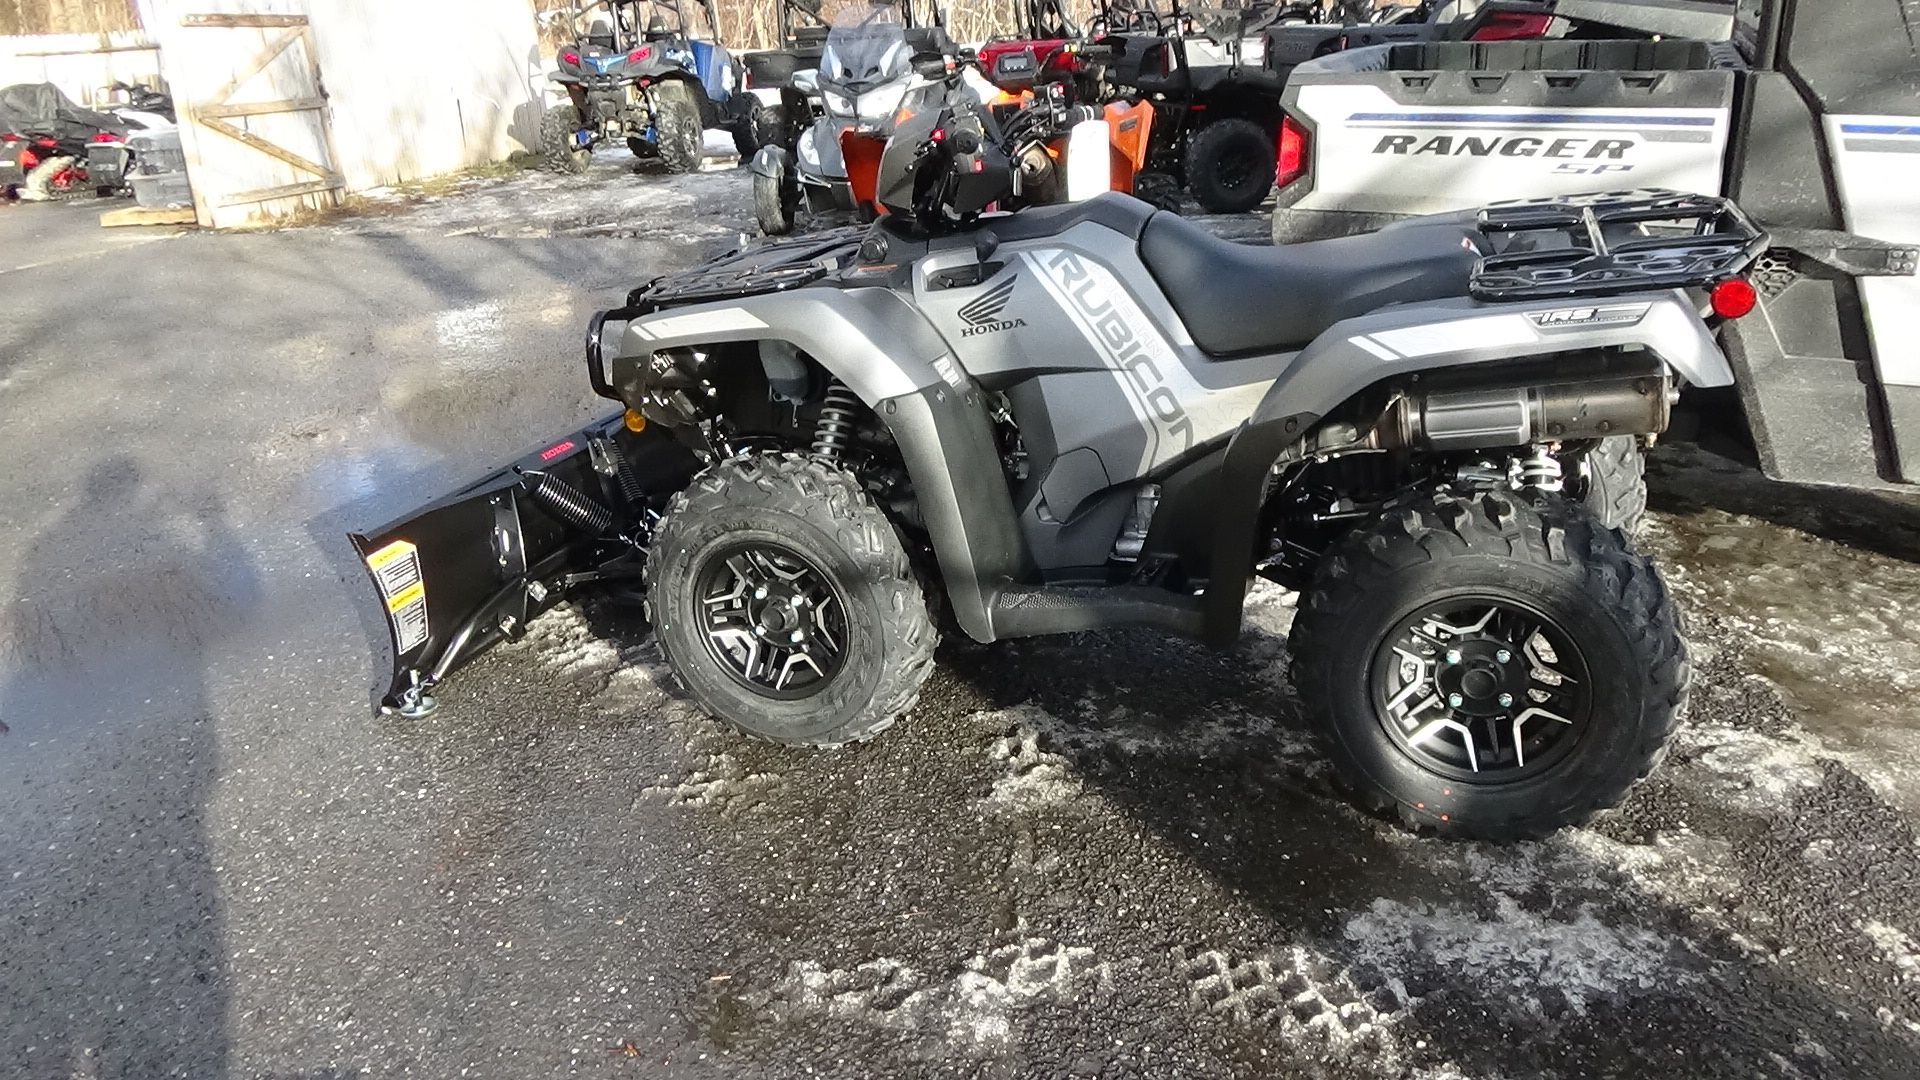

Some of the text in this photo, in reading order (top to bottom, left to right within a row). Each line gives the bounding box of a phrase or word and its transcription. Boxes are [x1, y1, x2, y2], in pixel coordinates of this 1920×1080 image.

[1371, 135, 1635, 159] RANGER
[1552, 163, 1635, 175] SP
[961, 318, 1027, 338] HONDA
[1048, 250, 1194, 452] RUBICON
